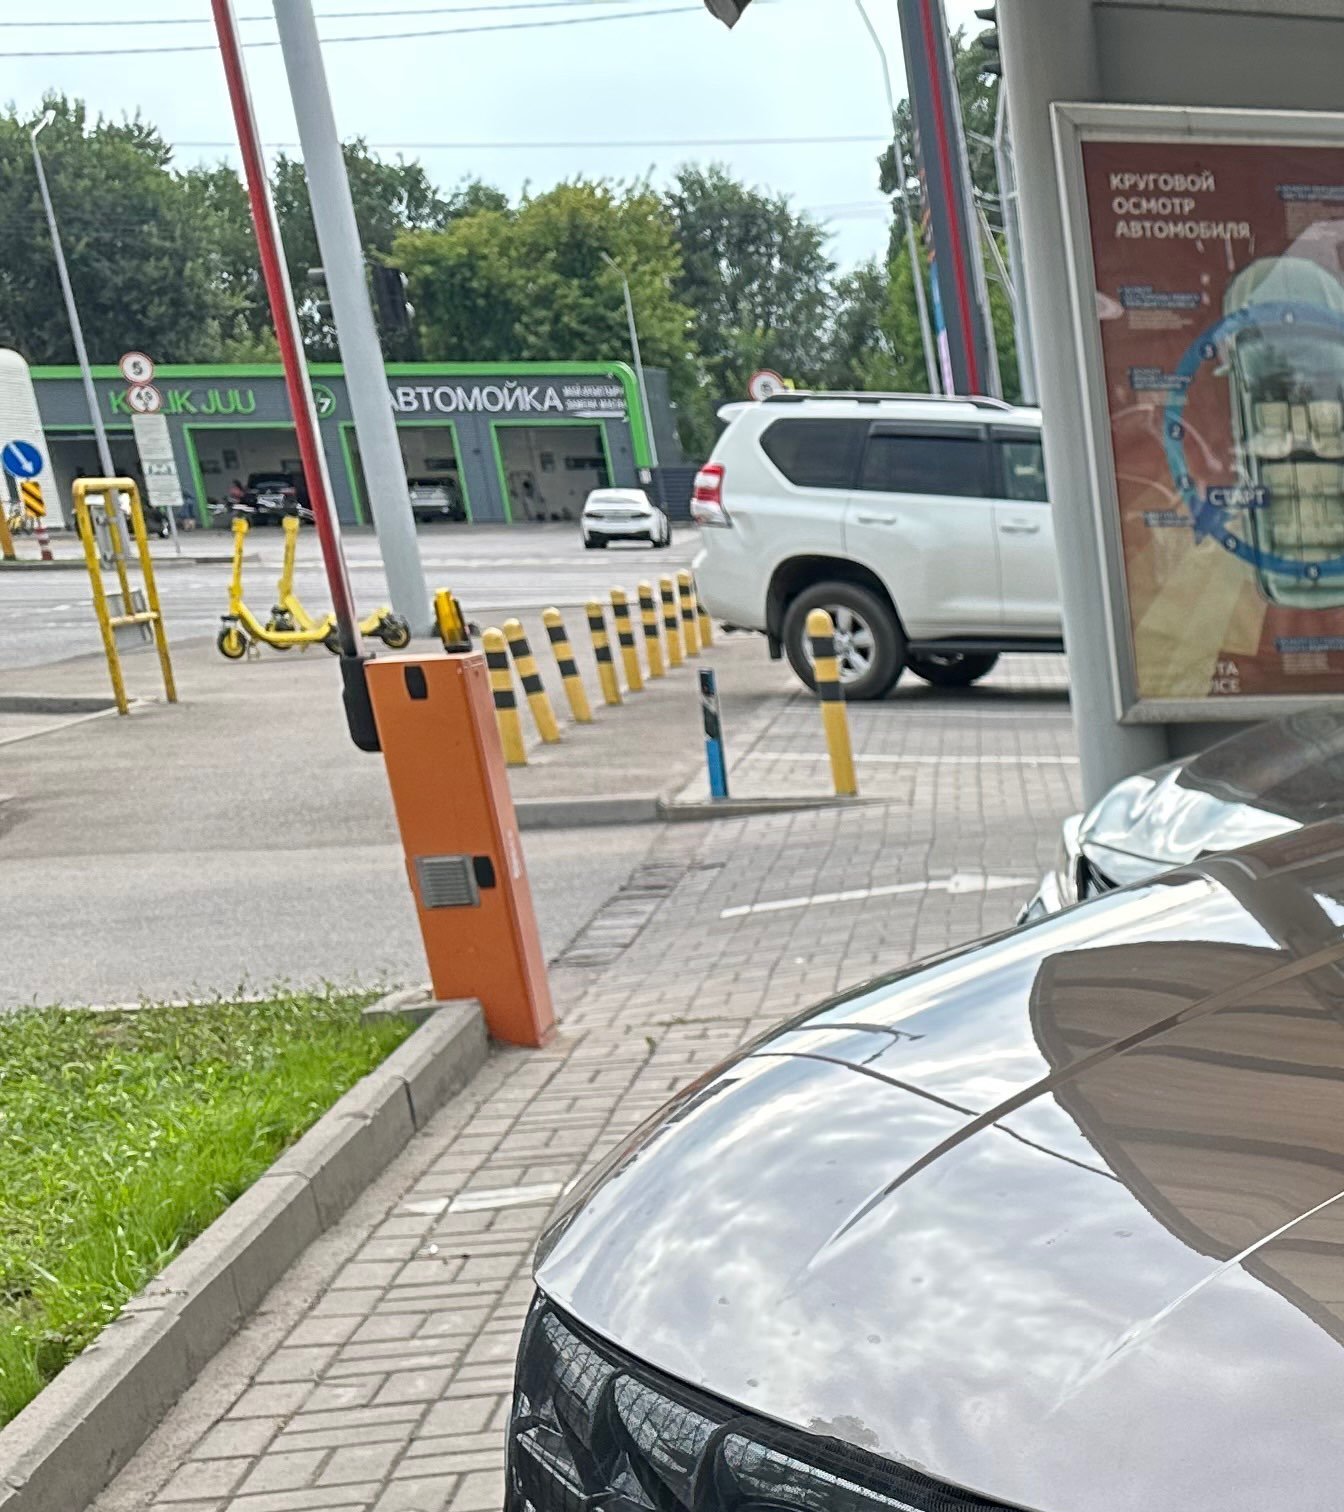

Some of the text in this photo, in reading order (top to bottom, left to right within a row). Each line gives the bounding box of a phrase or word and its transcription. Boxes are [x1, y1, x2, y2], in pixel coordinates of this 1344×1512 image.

[1109, 169, 1216, 192] КРУГОВОЙ
[1112, 198, 1196, 215] ОСМОТР
[1115, 220, 1251, 240] АВТОМОБИЛЯ
[1209, 488, 1266, 506] СТАРТ
